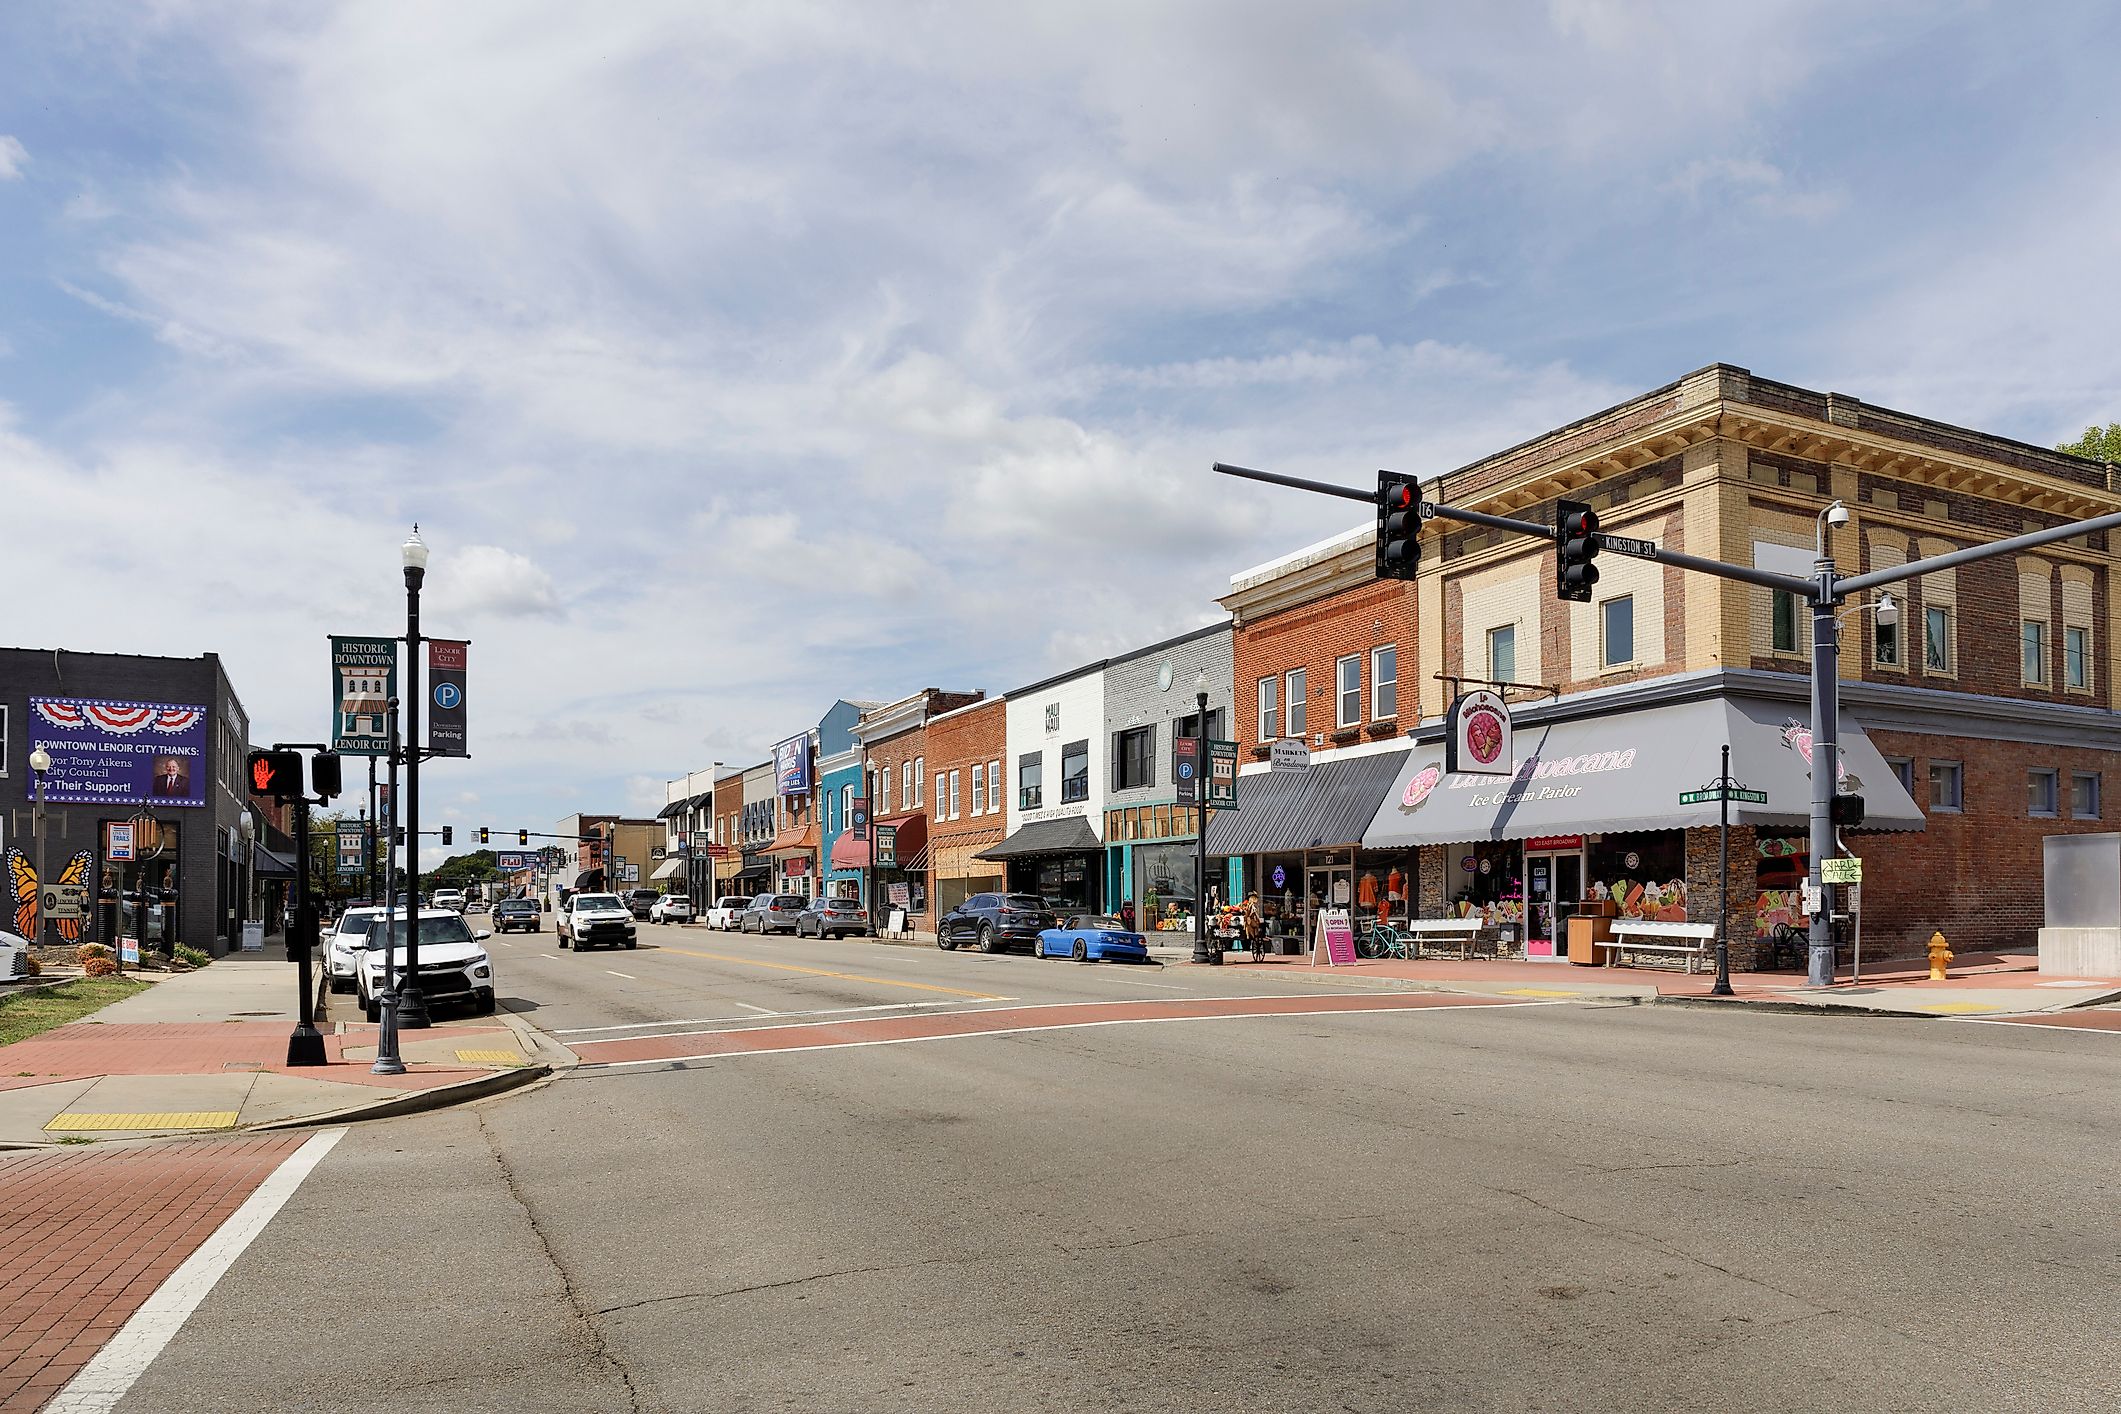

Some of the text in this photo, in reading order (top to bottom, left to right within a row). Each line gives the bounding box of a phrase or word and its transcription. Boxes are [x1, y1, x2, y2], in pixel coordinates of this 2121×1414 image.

[1606, 536, 1654, 556] KINGSTON ST.
[342, 643, 388, 654] HISTORIC
[434, 646, 460, 654] LENOIR
[334, 654, 394, 664] DOWNTOWN
[432, 730, 462, 740] Parking
[34, 740, 200, 756] DOWNTOWN LENOIR CITY THANKS:
[334, 739, 390, 750] LENOIR CIT
[71, 757, 96, 768] Tony
[98, 758, 132, 768] Aikens
[1273, 758, 1307, 771] Broadway
[46, 768, 109, 778] City Council
[54, 780, 83, 791] Their
[85, 781, 131, 793] Support!
[1468, 784, 1582, 808] Ice Cream Parlor
[1826, 860, 1855, 871] YARD
